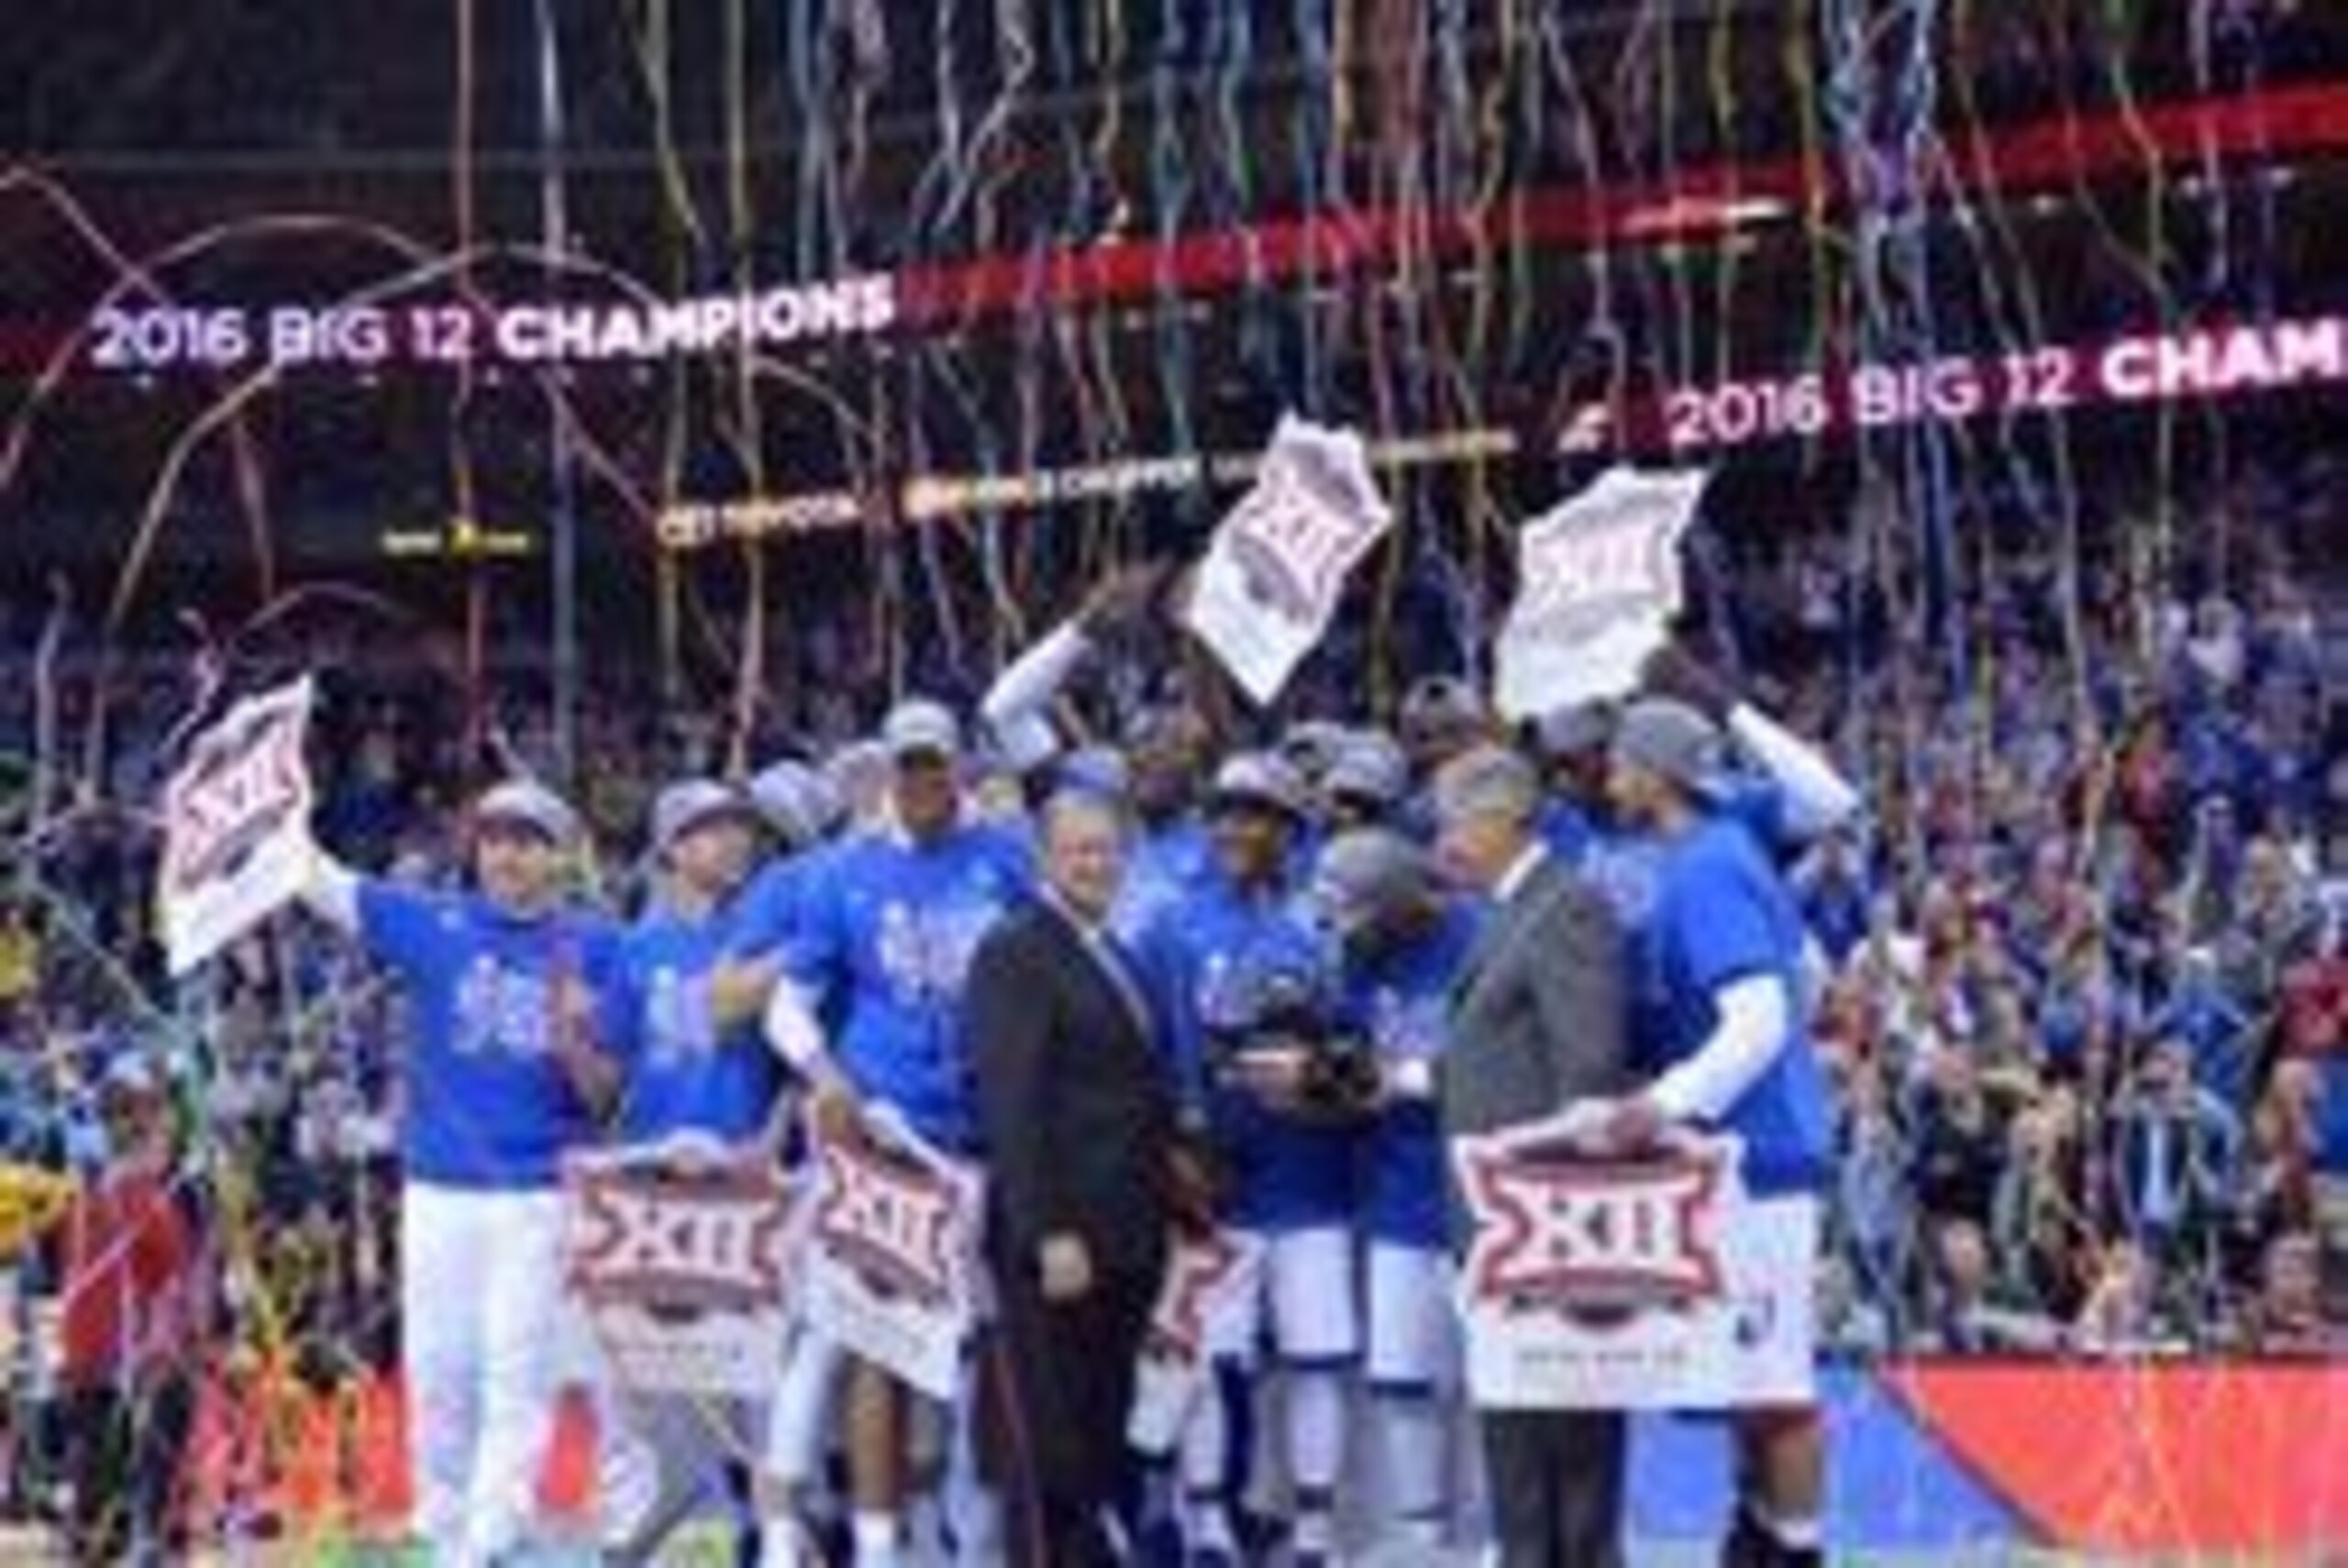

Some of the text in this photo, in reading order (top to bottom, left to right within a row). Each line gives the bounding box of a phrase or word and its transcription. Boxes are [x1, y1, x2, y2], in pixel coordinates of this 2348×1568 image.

[93, 273, 895, 367] 2016 BIG 12 CHAMPIONS
[1665, 376, 1827, 445] 2016
[1851, 356, 1981, 424] BIG
[2003, 347, 2075, 407] 12
[587, 1187, 775, 1287] XII
[825, 1146, 950, 1280] XII
[1495, 1172, 1706, 1280] XII
